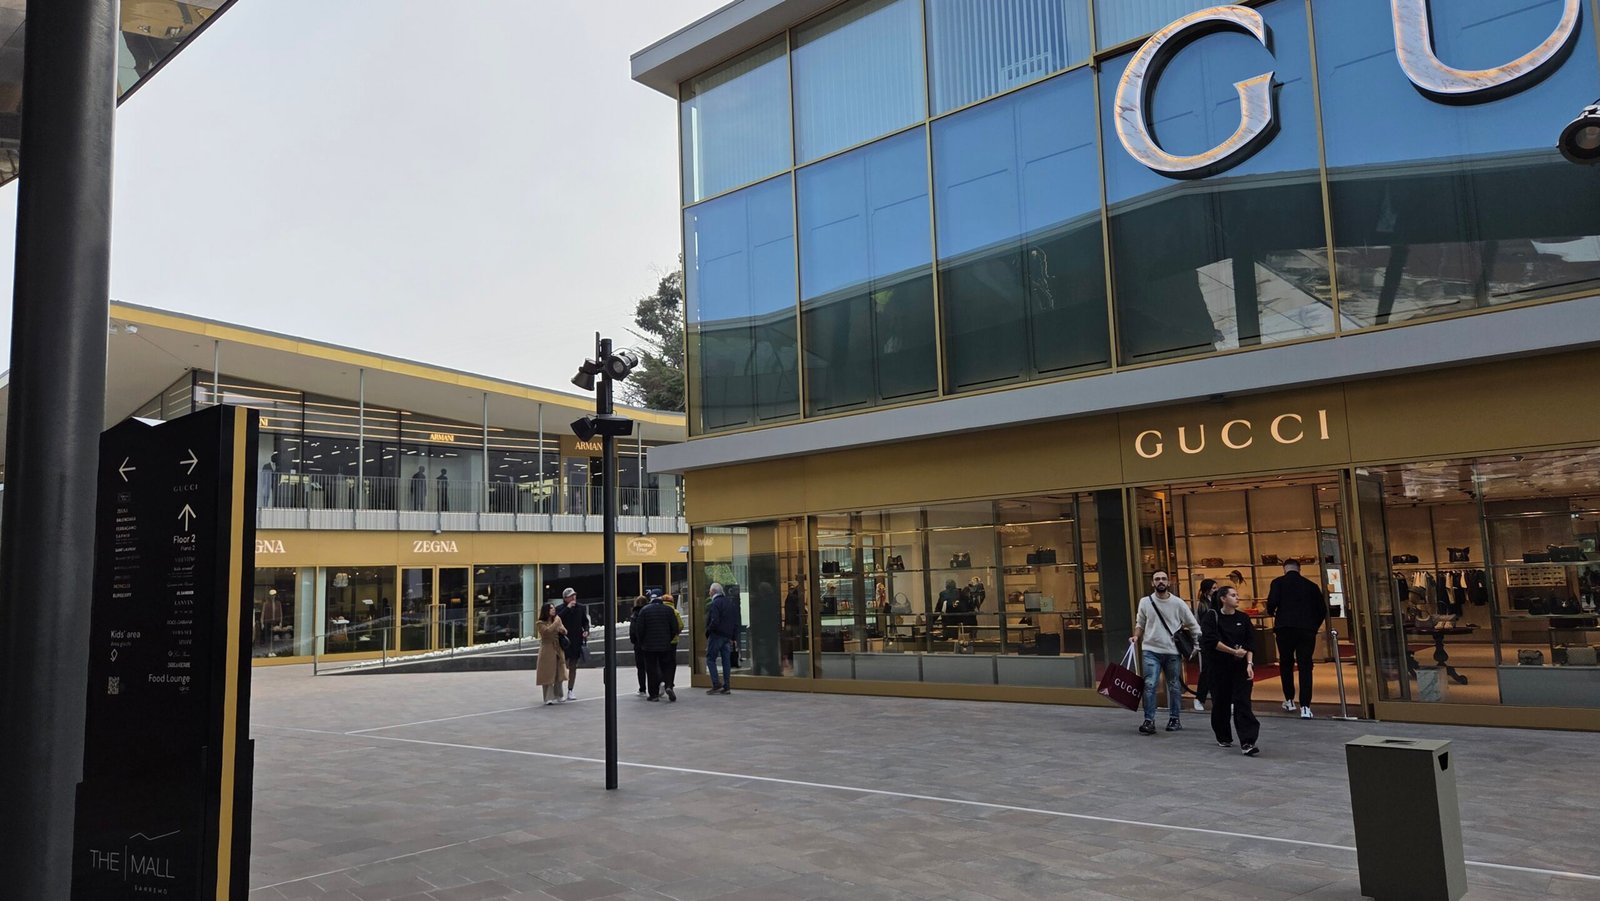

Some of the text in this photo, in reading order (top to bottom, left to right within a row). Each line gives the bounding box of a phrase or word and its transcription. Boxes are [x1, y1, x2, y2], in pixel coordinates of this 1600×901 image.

[1135, 409, 1330, 459] GUCCI
[574, 441, 603, 451] ARMAN
[173, 533, 196, 544] Floor 2
[255, 539, 286, 554] GNA
[413, 540, 459, 553] ZEGNA
[127, 631, 141, 639] area
[148, 674, 191, 685] Food Lounge
[1114, 677, 1142, 699] GUCCI
[89, 849, 176, 879] THE MALL
